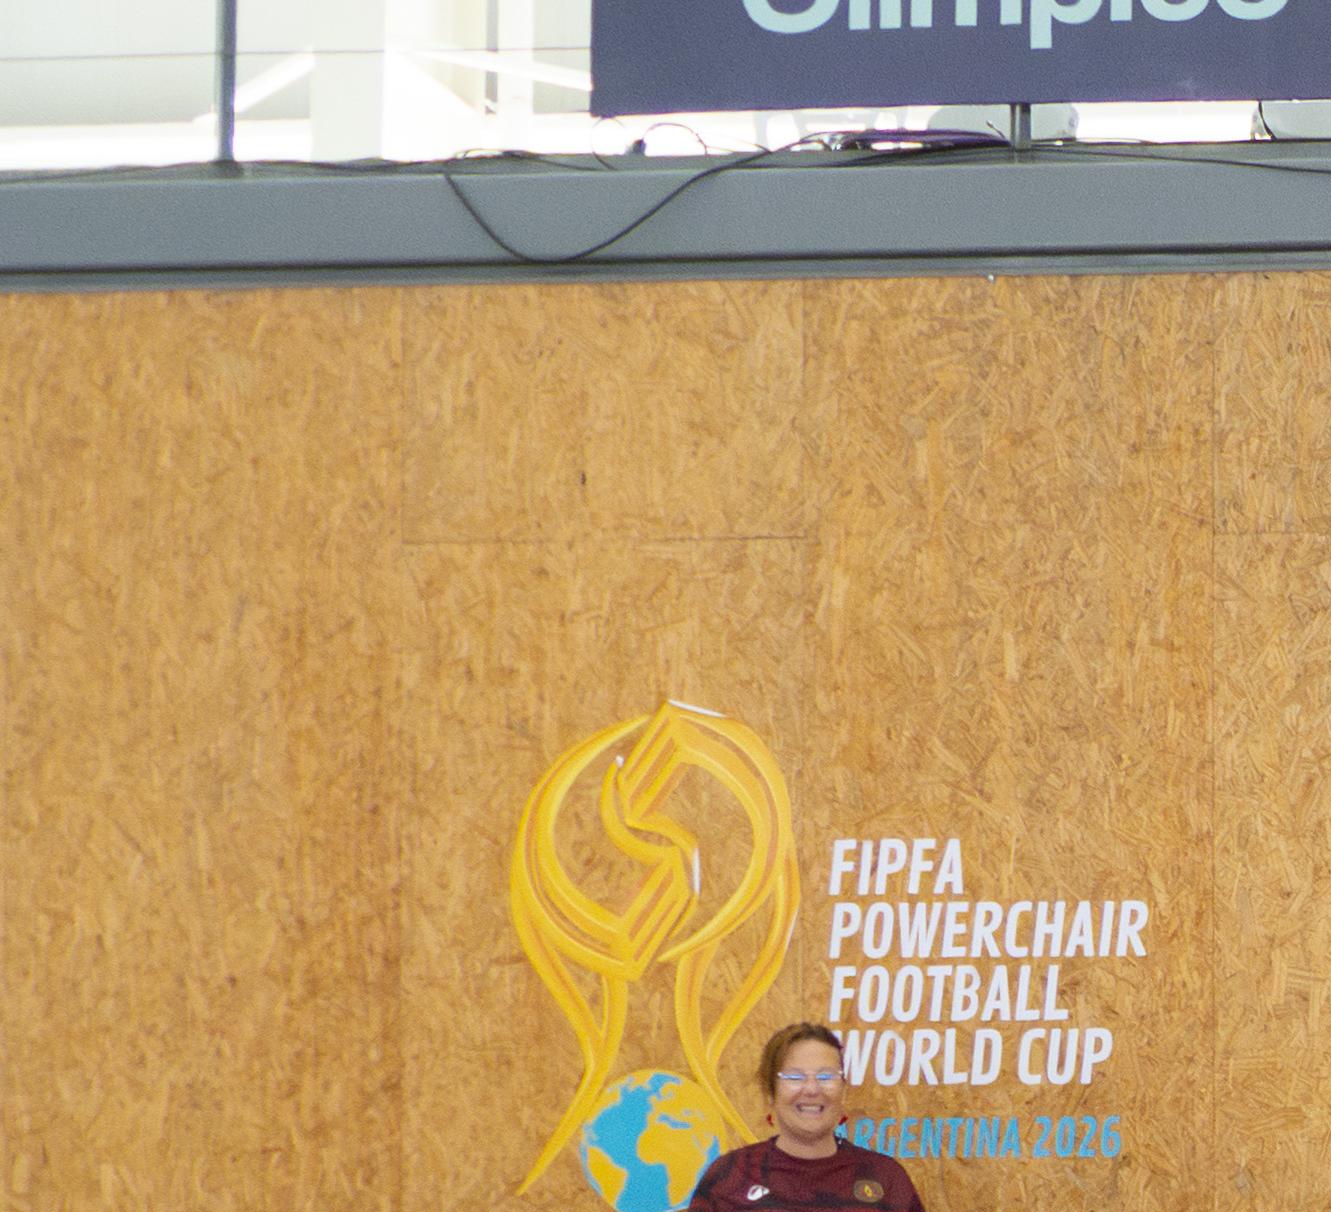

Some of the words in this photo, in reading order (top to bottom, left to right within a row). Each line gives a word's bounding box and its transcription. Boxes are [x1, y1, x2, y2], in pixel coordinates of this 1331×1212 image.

[828, 838, 964, 895] FIPFA
[828, 900, 1149, 959] POWERCHAIR
[829, 965, 1069, 1022] FOOTBALL
[831, 1028, 1003, 1086] WORLD
[1017, 1027, 1114, 1085] CUP
[1032, 1115, 1122, 1158] 2026
